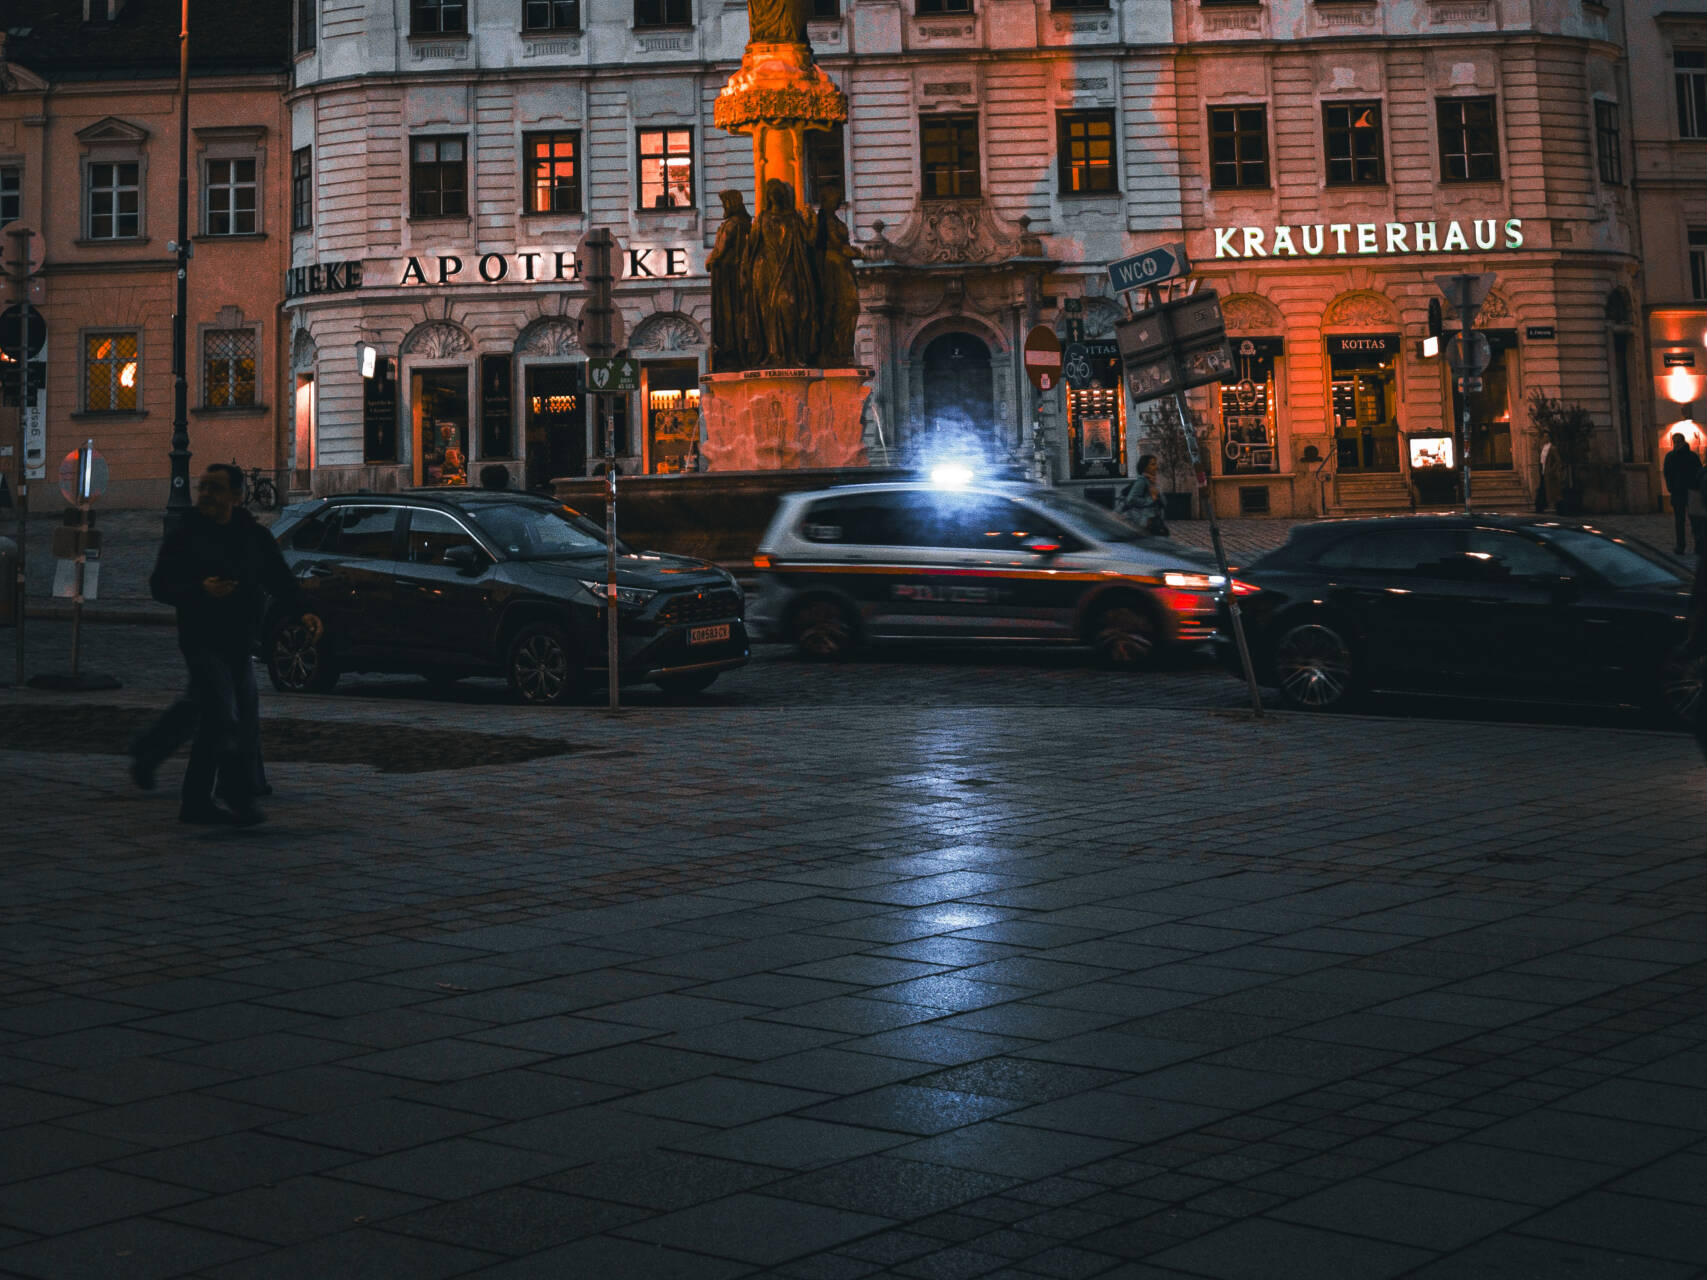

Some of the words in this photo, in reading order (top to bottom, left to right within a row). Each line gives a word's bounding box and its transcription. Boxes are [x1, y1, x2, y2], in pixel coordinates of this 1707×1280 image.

[400, 248, 689, 284] APOTHKE
[1118, 261, 1143, 283] WC
[1086, 344, 1119, 355] TTAS
[1341, 339, 1385, 350] KOTTAS
